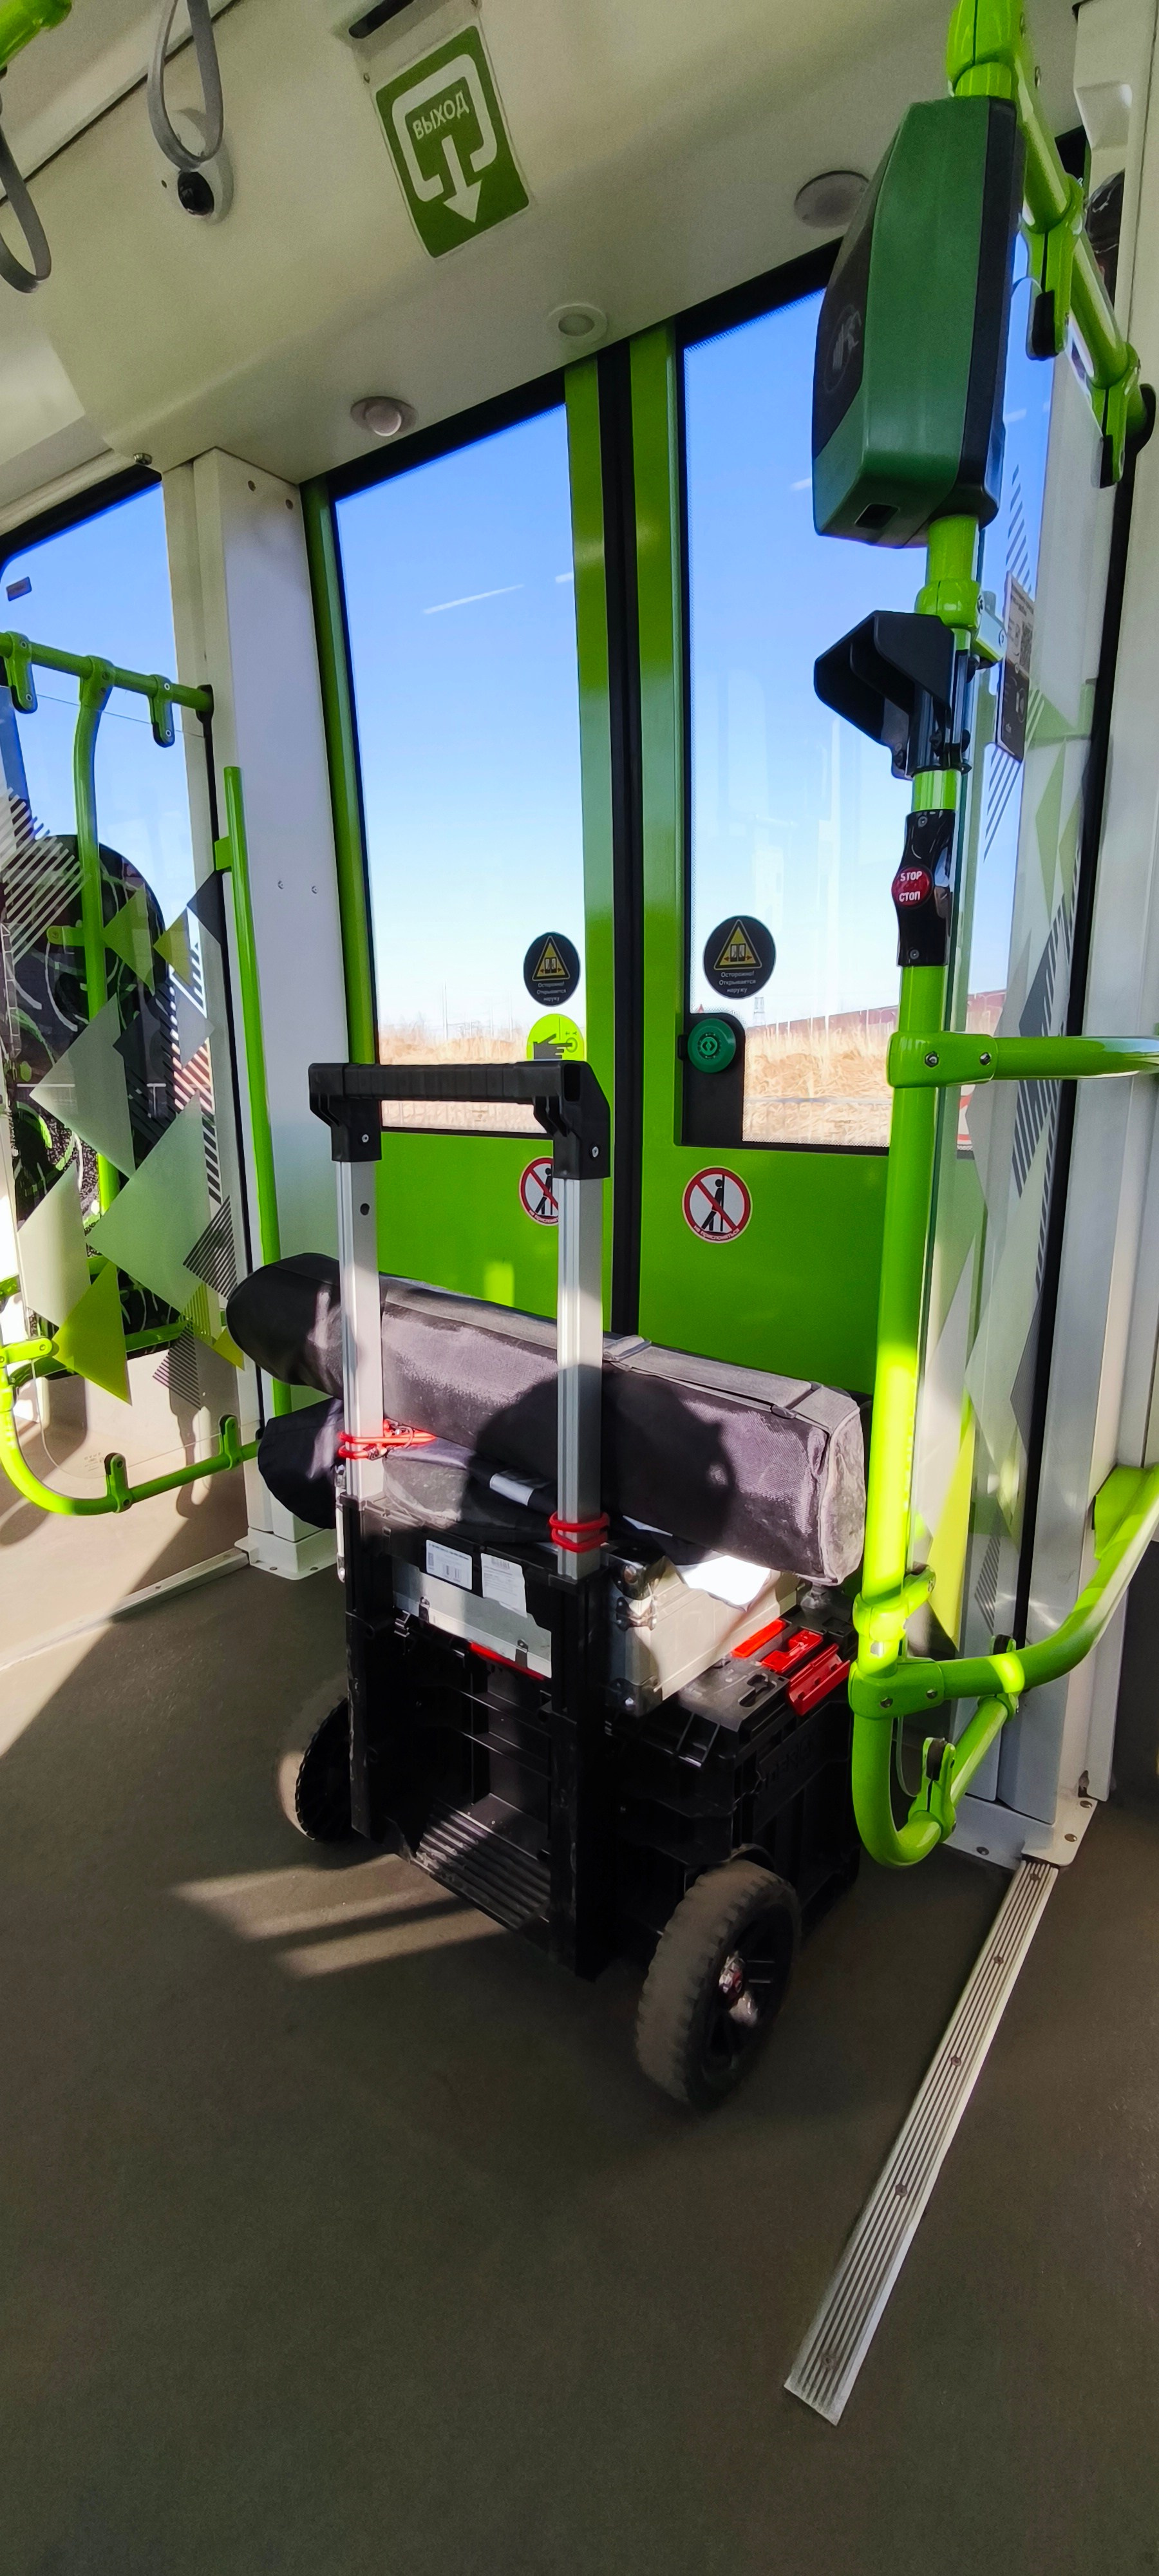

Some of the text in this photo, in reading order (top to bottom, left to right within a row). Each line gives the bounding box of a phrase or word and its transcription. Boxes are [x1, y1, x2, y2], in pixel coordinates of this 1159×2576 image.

[413, 90, 469, 140] ВЫХОД
[900, 871, 923, 882] STOP
[899, 891, 921, 902] СТОП
